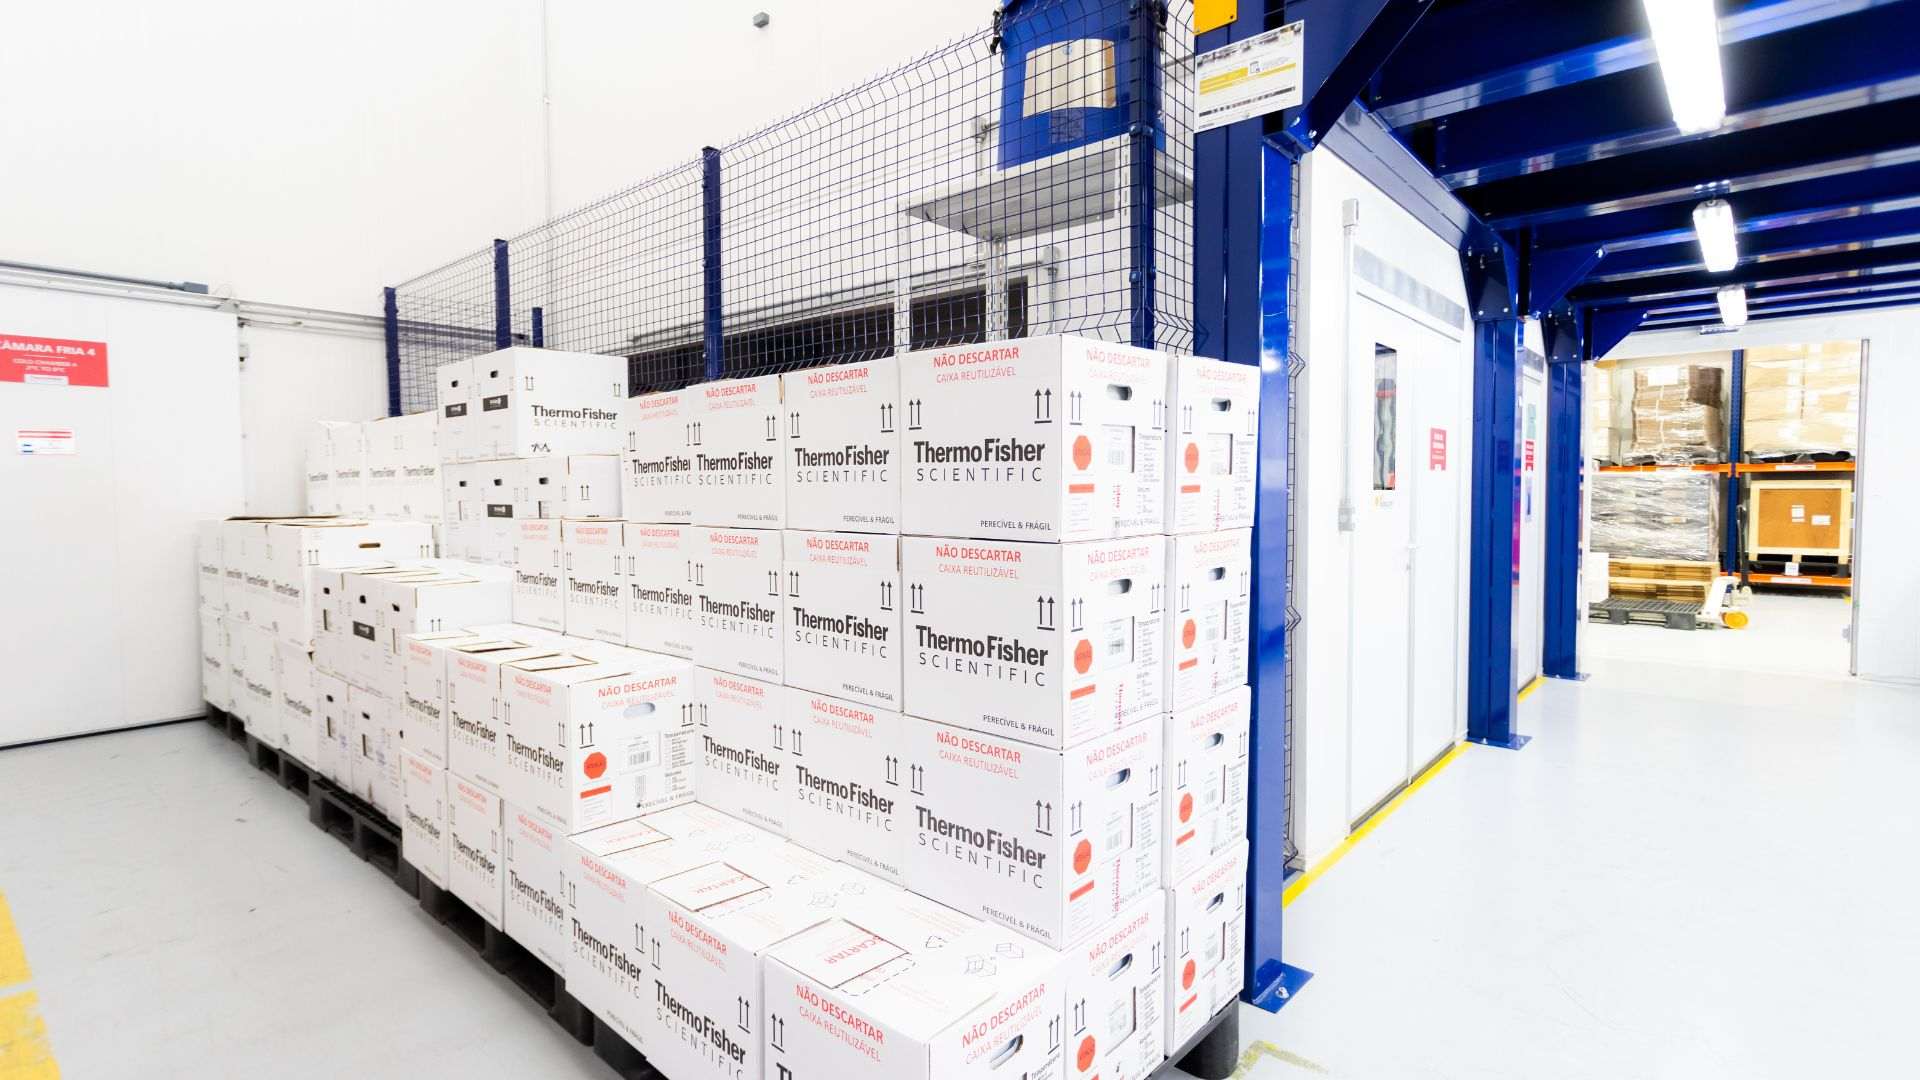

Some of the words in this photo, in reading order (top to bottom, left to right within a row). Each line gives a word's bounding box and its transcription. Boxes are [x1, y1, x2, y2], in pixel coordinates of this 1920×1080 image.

[0, 339, 53, 353] ÂMARA
[932, 353, 955, 368] NÃO
[958, 347, 1020, 365] DESCARTAR
[808, 372, 825, 385] NÃO
[825, 367, 869, 384] DESCARTAR
[936, 370, 958, 383] CAIXA
[961, 366, 1017, 380] REUTILIZÁVEL
[698, 473, 773, 485] SCIENTIFIC
[797, 470, 888, 482] SCIENTIFIC
[916, 467, 1043, 482] SCIENTIFIC
[980, 519, 1016, 529] PERECÍVEL
[1018, 521, 1023, 529] &
[1026, 520, 1052, 531] FRÁGIL
[723, 535, 759, 546] DESCARTAR
[806, 537, 823, 548] NÃO
[825, 538, 870, 553] DESCARTAR
[936, 543, 957, 558] NÃO
[961, 547, 1022, 563] DESCARTAR
[938, 563, 961, 574] CAIXA
[963, 564, 1019, 579] REUTILIZÁVEL
[701, 615, 774, 640] SCIENTIFIC
[795, 630, 887, 660] SCIENTIFIC
[919, 652, 1046, 687] SCIENTIFIC
[598, 685, 621, 698] NÃO
[623, 676, 678, 693] DESCARTAR
[811, 699, 827, 713] NÃO
[829, 704, 875, 725] DESCARTAR
[983, 714, 1018, 729] PERECÍVEL
[1020, 722, 1026, 731] &
[936, 731, 958, 747] NÃO
[961, 739, 1021, 763] DESCARTAR
[704, 754, 779, 792] SCIENTIFIC
[938, 750, 962, 764] CAIXA
[963, 756, 1019, 779] REUTILIZÁVEL
[799, 788, 893, 833] SCIENTIFIC
[918, 832, 1043, 889] SCIENTIFIC
[982, 905, 1017, 927] PERECÍVEL
[1019, 919, 1025, 930] &
[668, 910, 683, 929] NÃO
[684, 920, 727, 956] DESCARTAR
[1089, 942, 1107, 961] NÃO
[573, 940, 640, 999] SCIENTIFIC
[796, 983, 819, 1007] NÃO
[821, 998, 884, 1045] DESCARTAR
[962, 1022, 987, 1048] NÃO
[990, 983, 1045, 1030] DESCARTAR
[656, 1007, 744, 1080] SCIENTIFIC
[799, 1005, 823, 1028] CAIXA
[824, 1019, 881, 1063] REUTILIZÁVEL
